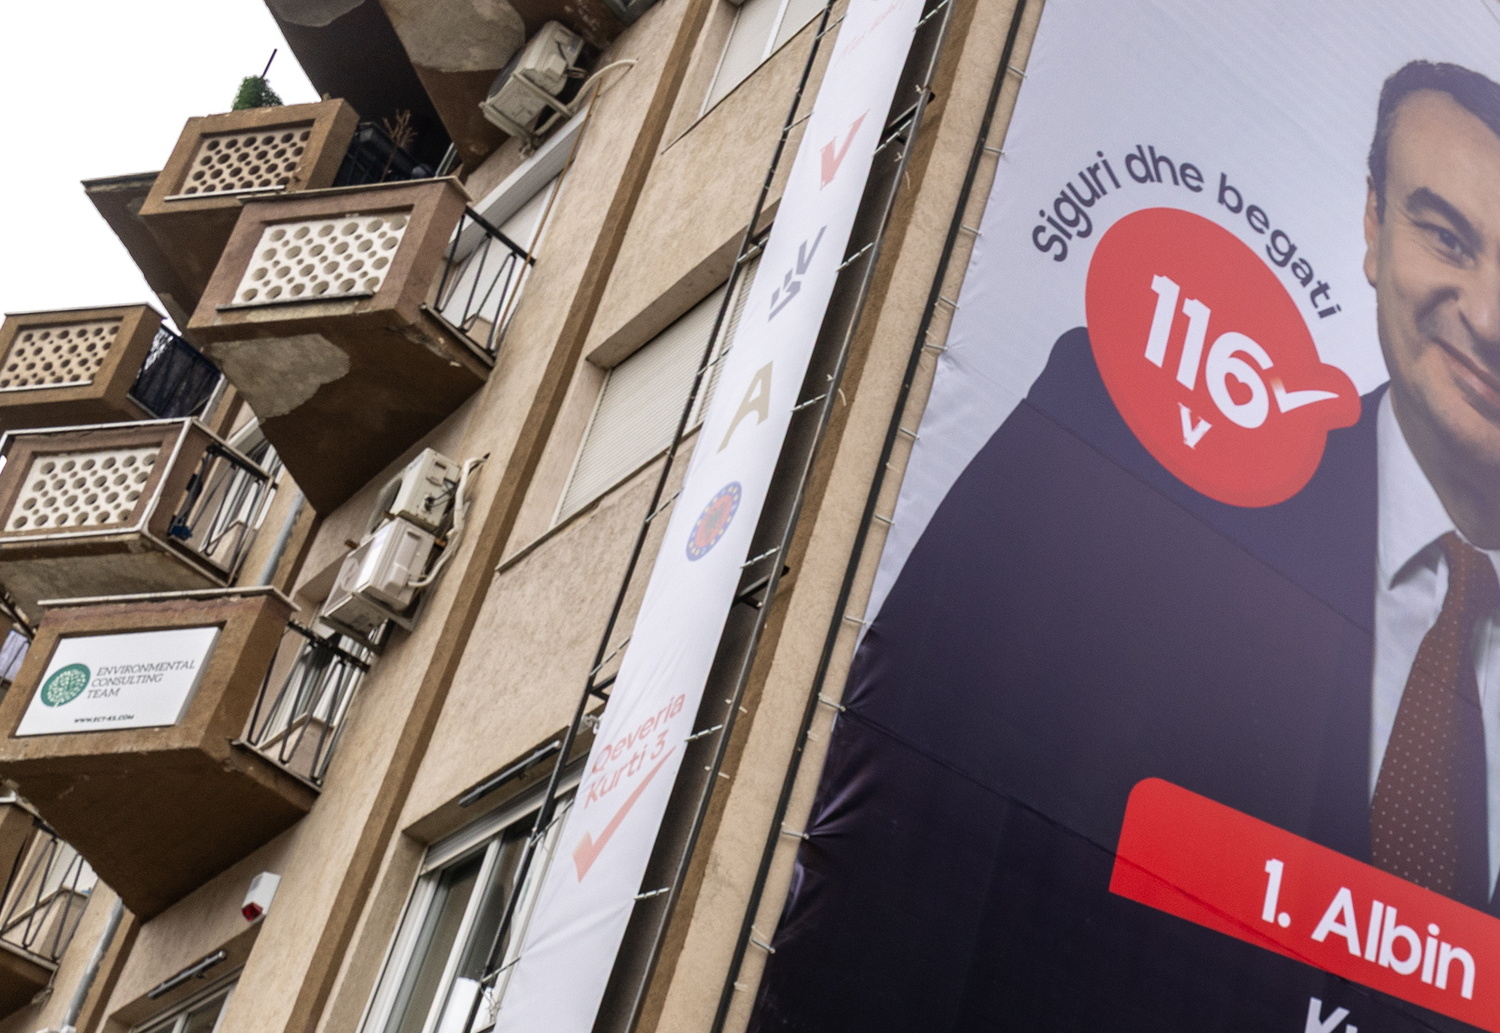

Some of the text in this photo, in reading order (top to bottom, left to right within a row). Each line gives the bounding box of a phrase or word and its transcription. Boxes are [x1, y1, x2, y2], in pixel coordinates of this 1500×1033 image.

[1031, 144, 1341, 319] Siguri dhe begati
[1144, 273, 1274, 429] 116
[87, 687, 120, 699] TEAM
[91, 673, 164, 688] CONSULTING
[97, 659, 196, 676] ENVIRONMENTAL
[584, 729, 669, 809] Kurti 3
[592, 693, 686, 775] Qeveria
[1262, 858, 1477, 1000] 1. Albin
